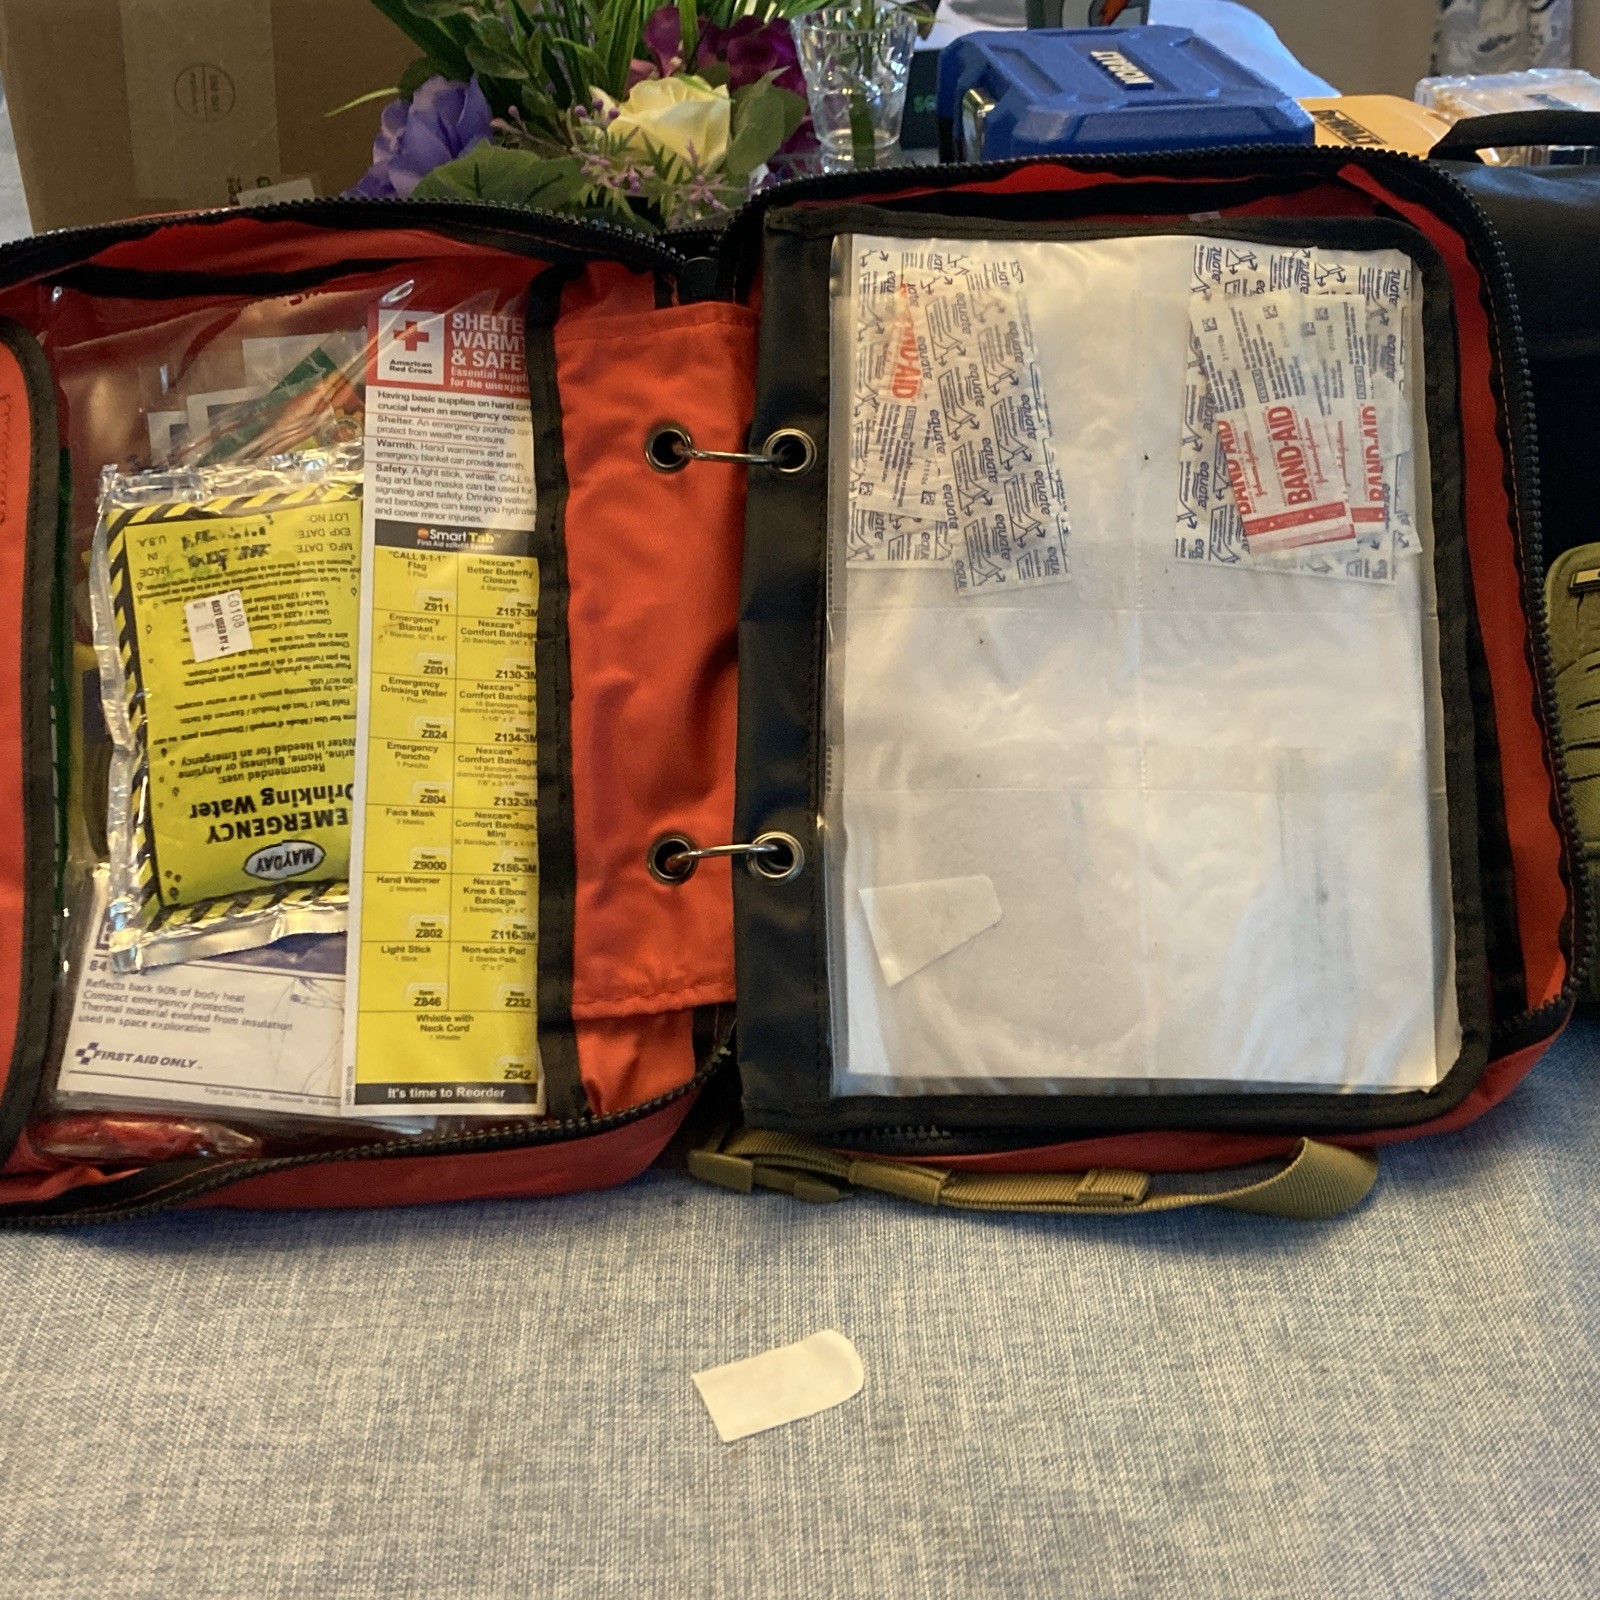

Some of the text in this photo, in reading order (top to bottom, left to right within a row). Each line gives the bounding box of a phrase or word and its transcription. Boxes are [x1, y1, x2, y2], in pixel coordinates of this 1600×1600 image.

[956, 292, 971, 336] equate
[451, 331, 524, 352] WARM
[1009, 321, 1025, 364] equate
[390, 359, 432, 367] American
[451, 349, 523, 371] & SAFE
[917, 336, 932, 380] equate
[1385, 334, 1396, 382] equate
[451, 367, 496, 379] Essential
[451, 378, 482, 388] for the
[969, 363, 985, 408] equate
[378, 391, 410, 401] Having
[412, 394, 435, 403] basic
[438, 396, 475, 407] supplies
[492, 400, 514, 410] hand
[378, 404, 408, 412] crucial
[410, 406, 434, 414] when
[450, 410, 499, 420] emergency
[1021, 394, 1036, 440] equate
[378, 415, 515, 435] Shelter. An emergency poncho
[377, 426, 463, 440] protect from weather
[930, 409, 946, 454] equate
[377, 440, 417, 450] Warmth.
[421, 443, 444, 451] Hand
[447, 446, 484, 456] warmers
[488, 450, 504, 458] and
[376, 452, 494, 468] emergency blanket provide
[982, 437, 997, 484] equate
[1267, 406, 1312, 505] BAND-AID
[376, 464, 438, 478] Safety. light
[376, 475, 391, 484] flag
[435, 480, 463, 489] masks
[1198, 460, 1210, 510] equate
[466, 493, 502, 504] Drinking
[1034, 470, 1050, 515] equate
[460, 504, 499, 513] keep you
[942, 483, 959, 530] equate
[328, 513, 349, 522] LOT
[430, 529, 466, 541] Smart
[995, 513, 1011, 561] equate
[147, 552, 158, 560] IN
[139, 565, 169, 577] MADE
[408, 562, 427, 571] Flag
[467, 567, 533, 578] Better Butterfly
[483, 576, 517, 585] Closure
[424, 602, 449, 612] Z911
[211, 600, 228, 647] BEST USED BY
[389, 613, 440, 625] Emergency
[398, 622, 432, 632] Blanket
[461, 628, 496, 637] Comfort
[389, 677, 440, 689] Emergency
[381, 686, 447, 697] Drinking Water
[459, 691, 496, 699] Comfort
[422, 730, 447, 739] Z824
[256, 748, 271, 756] for
[274, 743, 313, 755] Needed
[387, 742, 438, 753] Emergency
[182, 752, 237, 767] Emergency
[394, 752, 430, 761] Poncho
[458, 756, 495, 764] Comfort
[179, 753, 322, 779] Home, Business or Anytime
[219, 763, 326, 784] Recommended uses:
[190, 795, 257, 819] Water
[386, 808, 435, 817] Face Mask
[207, 808, 348, 844] EMERGENCY
[455, 820, 493, 829] Comfort
[487, 830, 506, 838] Mini
[255, 848, 315, 873] MAYDAY
[413, 861, 446, 870] Z9000
[377, 876, 440, 884] Hand Warmer
[463, 887, 527, 896] Knee & Elbow
[475, 896, 516, 905] Bandage
[416, 929, 443, 938] Z802
[381, 946, 431, 954] Light Stick
[509, 946, 526, 955] Pad
[86, 978, 245, 1002] Reflects back 90% of body heat
[84, 990, 244, 1014] Compact emergency protection
[505, 998, 531, 1007] Z232
[81, 1002, 292, 1030] Thermal material evolved from insulation
[79, 1015, 103, 1023] used
[119, 1019, 148, 1027] space
[151, 1021, 211, 1034] exploration
[420, 1024, 470, 1032] Neck Cord
[93, 1050, 198, 1068] FIRST AID ONLY
[388, 1088, 505, 1098] It's time to Reorder
